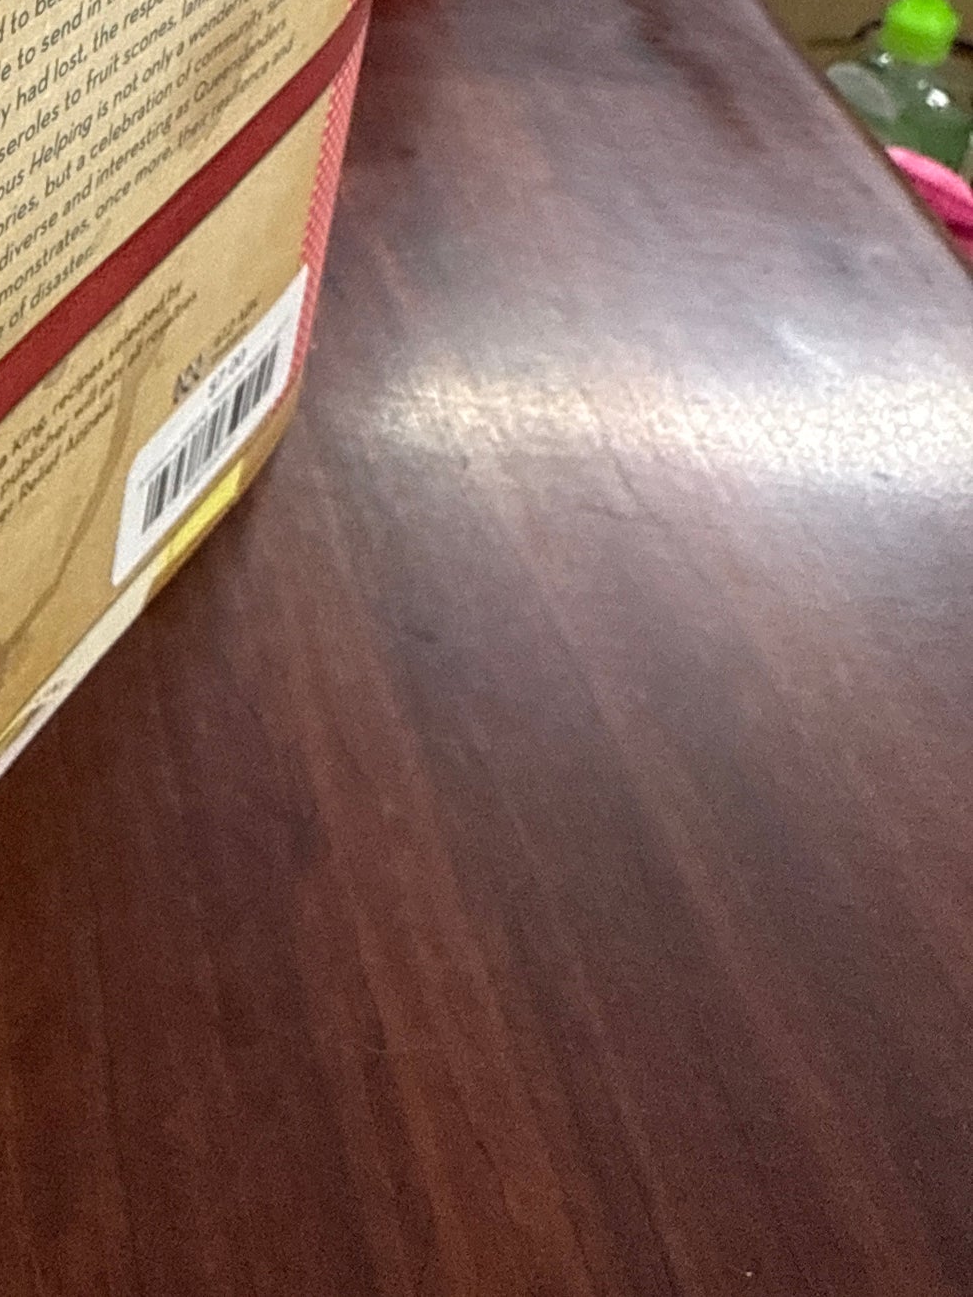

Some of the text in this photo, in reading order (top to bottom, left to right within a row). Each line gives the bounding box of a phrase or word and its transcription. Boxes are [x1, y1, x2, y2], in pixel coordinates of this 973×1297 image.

[9, 5, 30, 36] to
[16, 41, 36, 72] to
[40, 0, 83, 54] send
[15, 62, 50, 112] had
[92, 18, 118, 54] the
[63, 83, 82, 112] to
[85, 50, 119, 95] fruit
[29, 111, 93, 177] Helping
[43, 157, 72, 199] but
[76, 150, 86, 173] a
[8, 291, 26, 328] of
